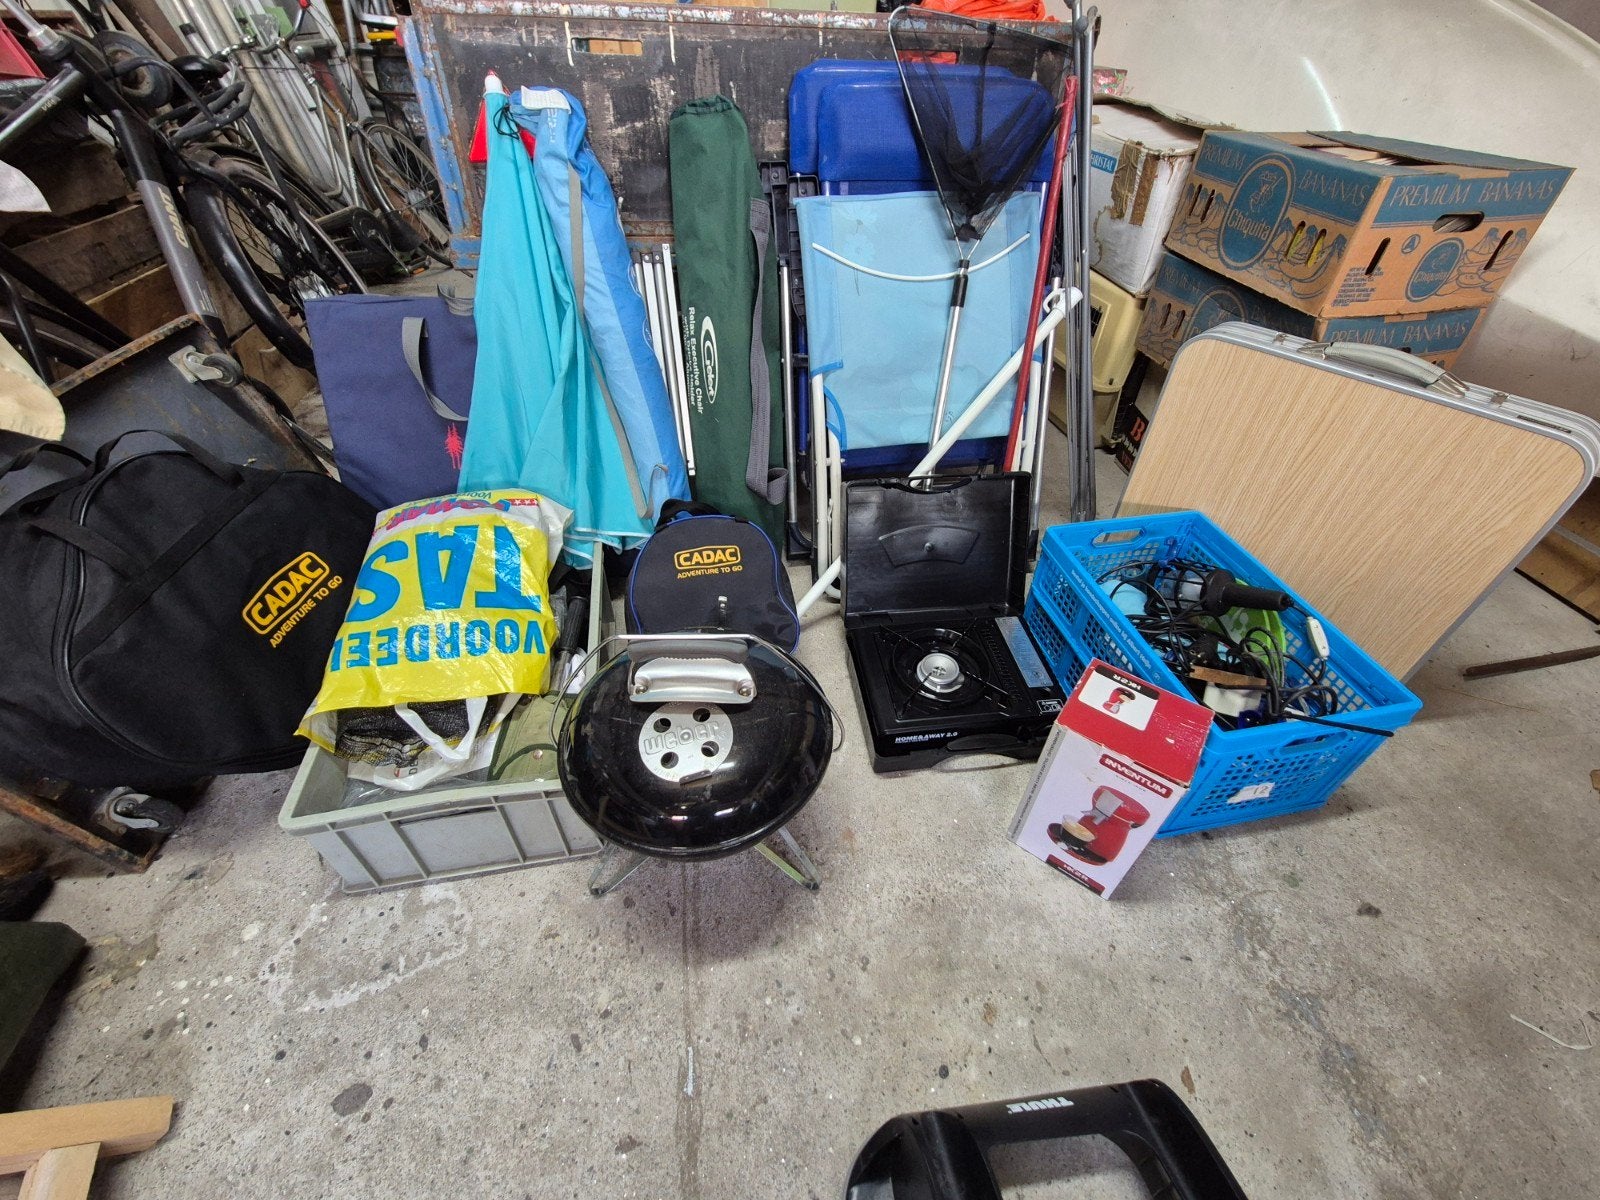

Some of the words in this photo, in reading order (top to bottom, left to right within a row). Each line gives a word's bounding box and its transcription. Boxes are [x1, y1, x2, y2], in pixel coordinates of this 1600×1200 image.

[1298, 170, 1369, 207] BANANAS
[1389, 184, 1471, 207] PREMIUM
[1478, 178, 1559, 203] BANANAS
[157, 187, 189, 249] GIANT
[1227, 209, 1272, 241] Chiquita
[688, 306, 696, 336] Relax
[1331, 327, 1396, 345] PREMIUM
[1403, 320, 1470, 343] BANANAS
[690, 338, 700, 386] Executive
[695, 387, 704, 414] Chair
[344, 524, 542, 623] TAS
[677, 567, 719, 580] ADVENTURE
[720, 566, 731, 574] TO
[679, 548, 737, 566] CADAC
[251, 557, 324, 626] CADAC
[269, 598, 317, 649] ADVENTURE
[312, 587, 329, 601] TO
[327, 575, 343, 590] GO
[643, 720, 719, 755] weber
[1104, 757, 1167, 795] INVENTUM
[1005, 1096, 1075, 1113] THULE
